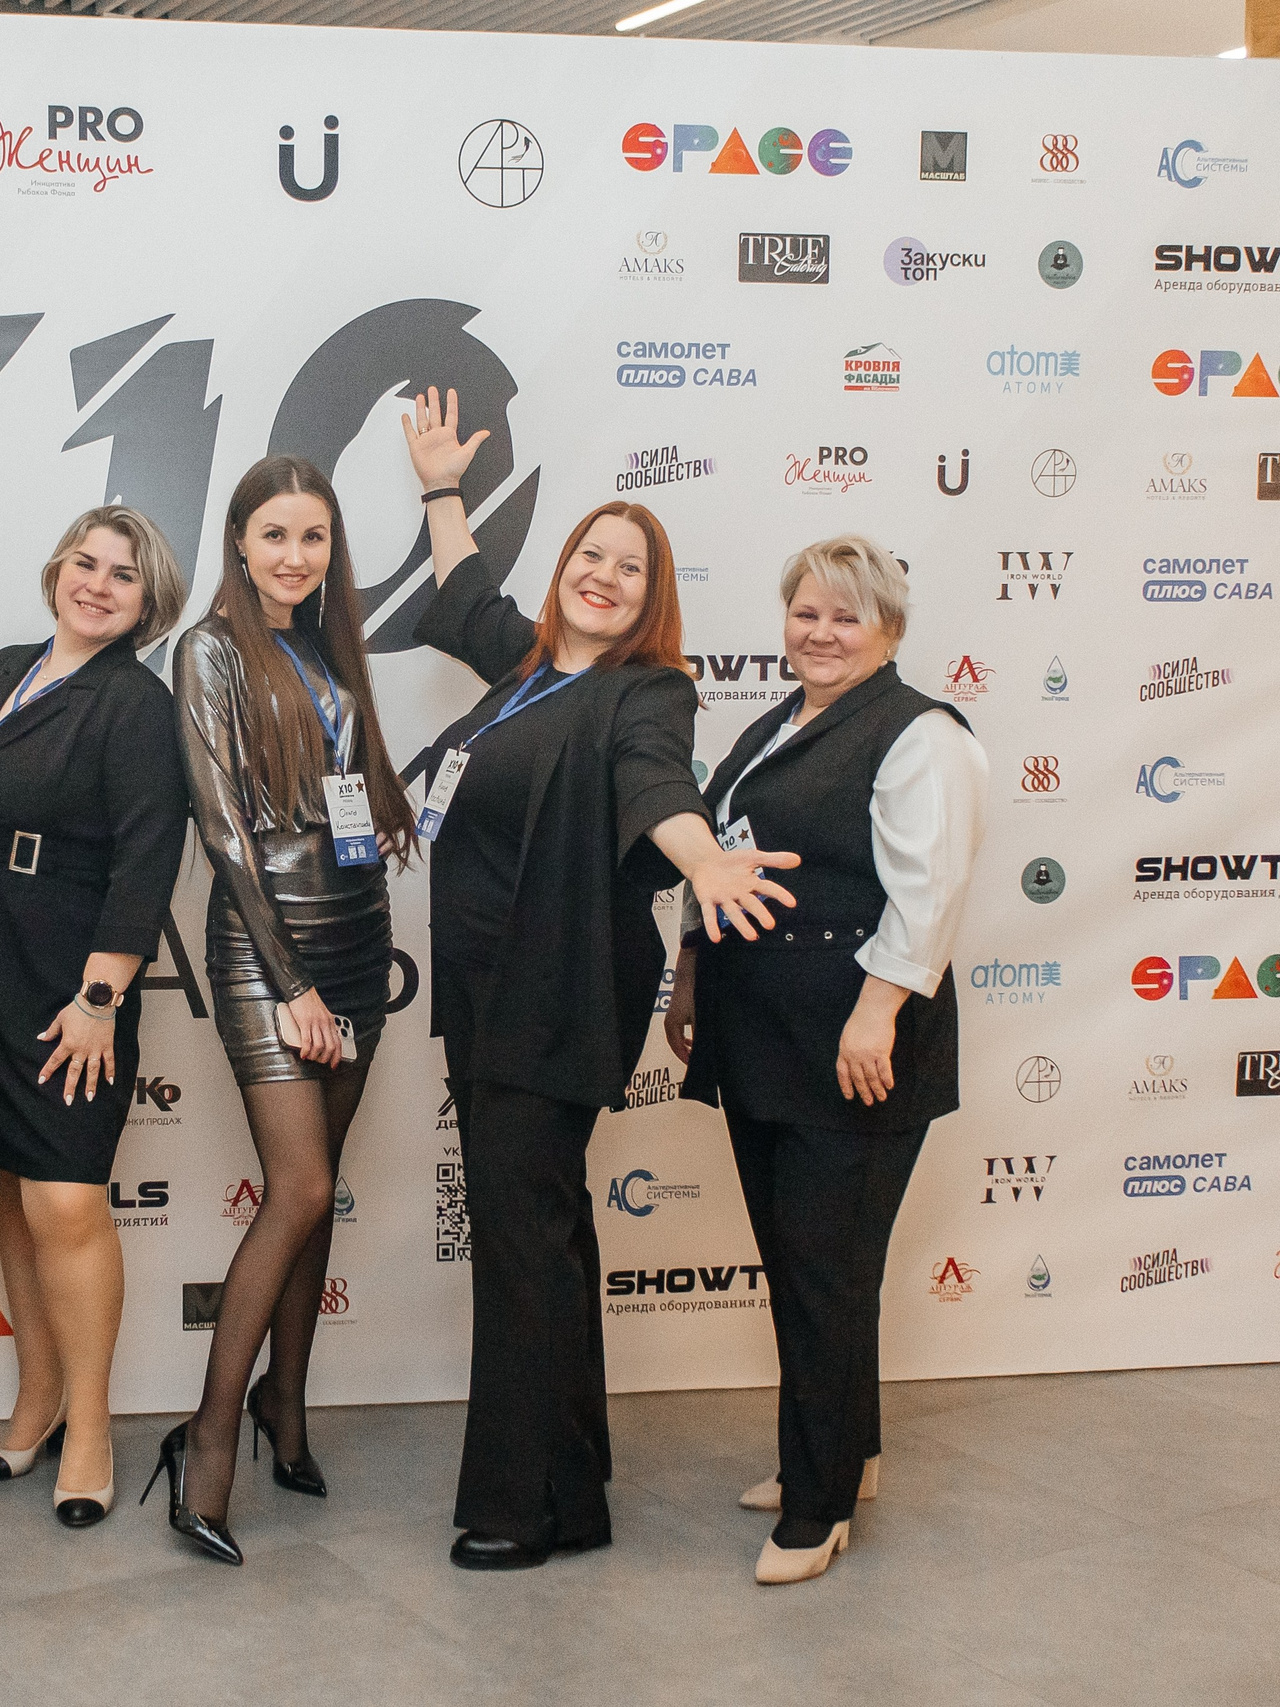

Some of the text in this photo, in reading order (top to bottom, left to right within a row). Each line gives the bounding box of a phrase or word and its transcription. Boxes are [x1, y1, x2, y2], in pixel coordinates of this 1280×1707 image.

[48, 105, 144, 143] PRO
[622, 122, 853, 177] SPACE
[921, 171, 965, 180] МАСШТАБ
[741, 235, 824, 265] TRUE
[900, 248, 986, 270] Закуски
[618, 257, 684, 274] AMAKS
[774, 253, 828, 283] Catering
[901, 266, 937, 281] топ
[1154, 279, 1202, 292] Аренда
[617, 341, 730, 360] самолет
[845, 360, 900, 373] КРОВЛЯ
[621, 367, 757, 386] плюс САВА
[844, 372, 900, 385] ФАСАДЫ
[1003, 381, 1064, 394] ATOMY
[640, 445, 678, 468] СИЛА
[819, 447, 868, 466] PRO
[616, 462, 701, 491] СООБЩЕСТВ
[785, 453, 872, 493] Женщин
[1146, 478, 1207, 493] AMAKS
[1143, 558, 1248, 575] самолет
[1147, 583, 1272, 600] плюс САВА
[1162, 657, 1198, 680] СИЛА
[1140, 671, 1220, 701] СООБЩЕСТВ
[1133, 888, 1275, 901] Аренда оборудования
[986, 991, 1045, 1004] ATOMY
[633, 1067, 670, 1090] СИЛА
[1128, 1079, 1187, 1094] AMAKS
[146, 1117, 182, 1126] ПРОДАЖ
[1124, 1152, 1227, 1171] самолет
[1128, 1175, 1252, 1195] плюс САВА
[1143, 1248, 1178, 1270] СИЛА
[1121, 1261, 1199, 1292] СООБЩЕСТВ
[606, 1299, 755, 1315] Аренда оборудования
